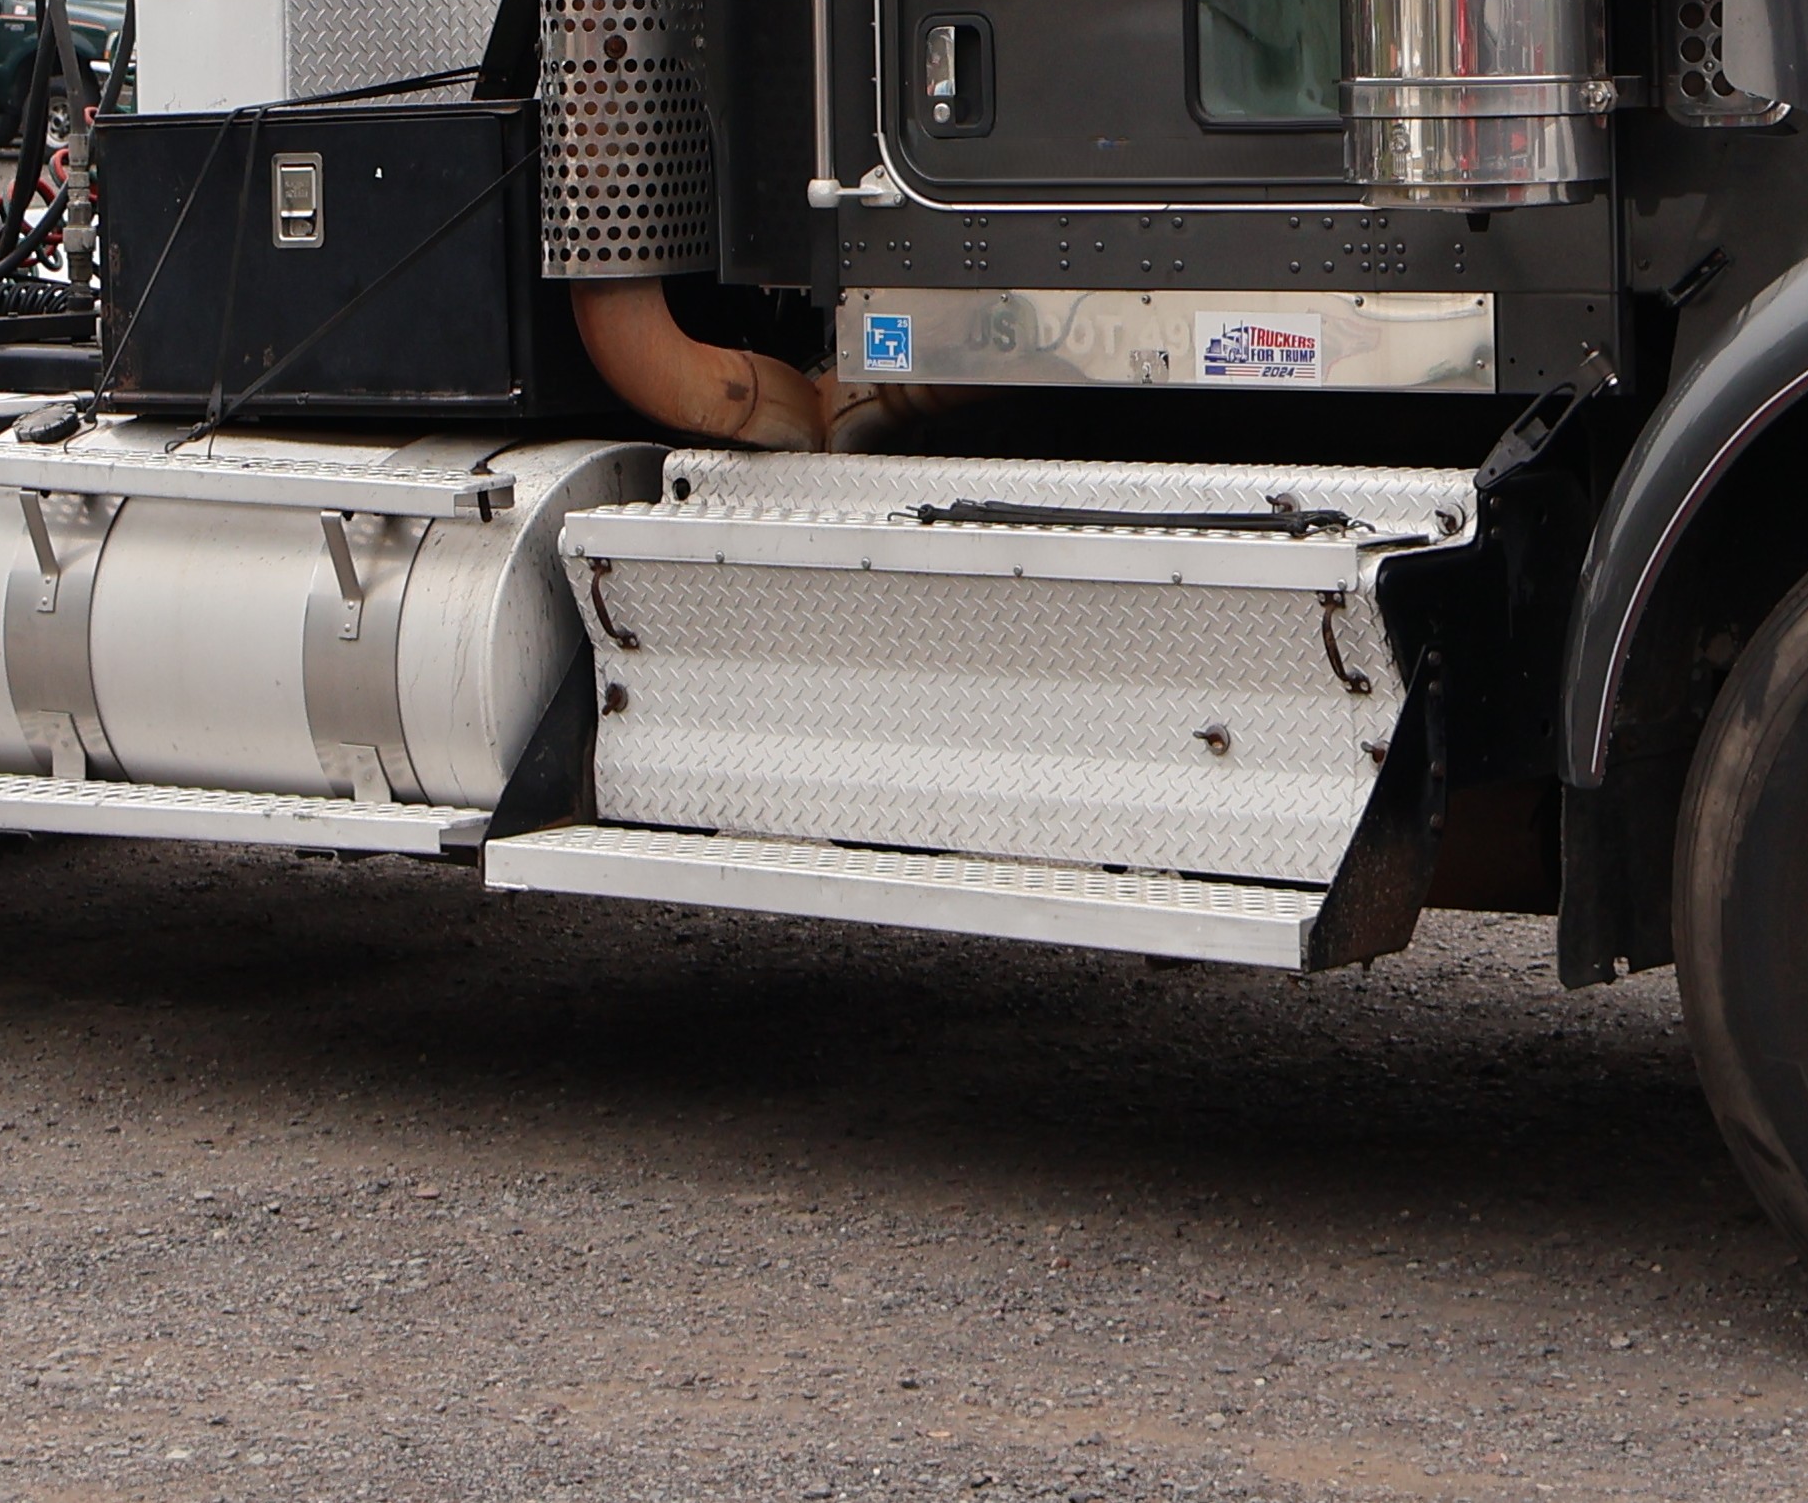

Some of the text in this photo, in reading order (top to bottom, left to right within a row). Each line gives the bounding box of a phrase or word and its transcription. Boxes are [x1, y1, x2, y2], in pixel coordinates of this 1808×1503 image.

[897, 319, 908, 328] 25
[1250, 326, 1316, 349] TRUCKERS
[1251, 348, 1316, 363] FOR TRUMP
[1262, 366, 1295, 377] 2024
